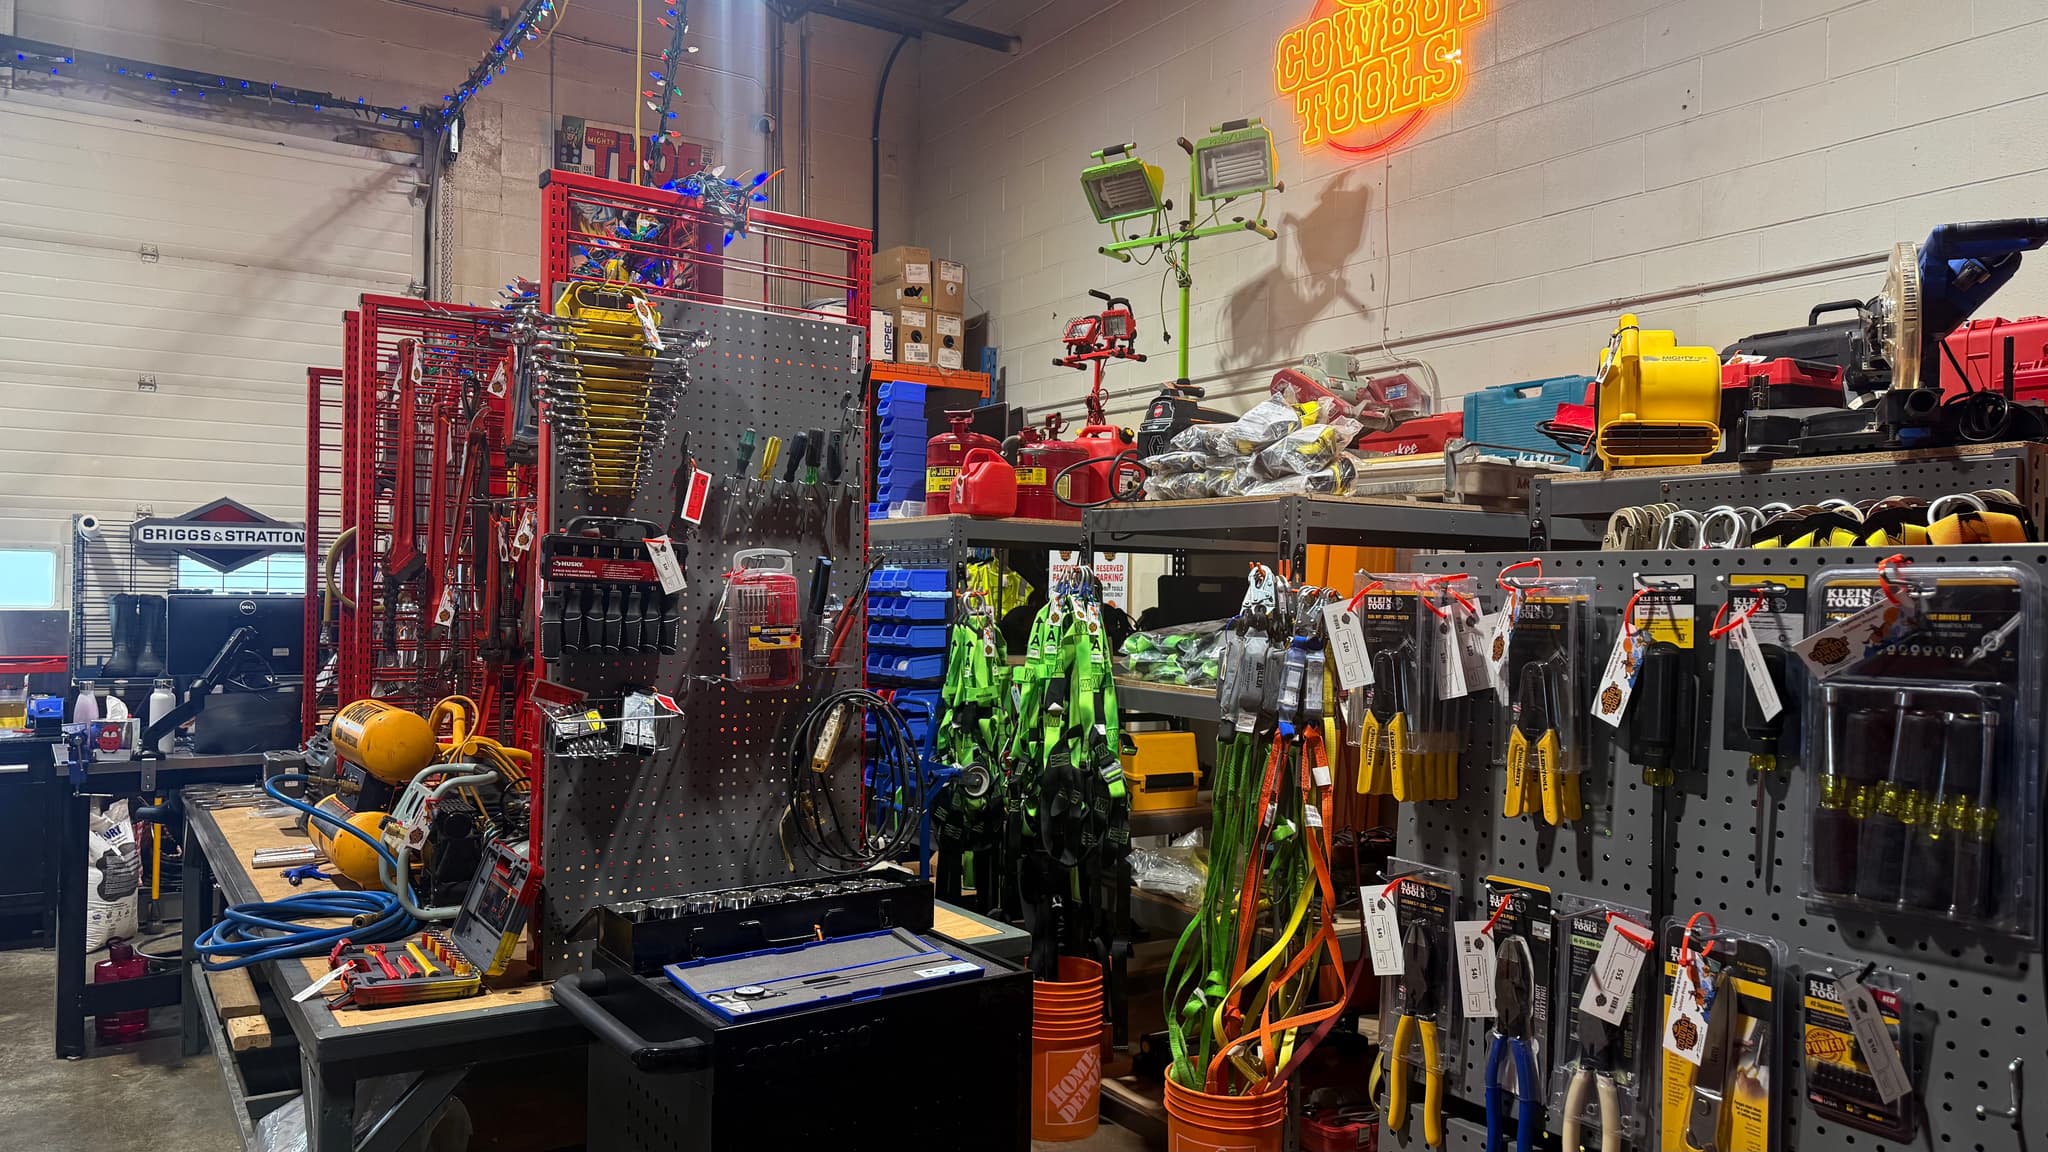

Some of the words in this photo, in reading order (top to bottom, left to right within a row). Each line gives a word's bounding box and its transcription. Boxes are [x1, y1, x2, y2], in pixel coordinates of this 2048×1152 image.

[1297, 29, 1457, 144] TOOLS
[587, 137, 615, 146] MIGHTY
[143, 528, 211, 541] BRIGGS
[213, 531, 223, 541] &
[225, 530, 305, 543] STRATTON
[1096, 564, 1124, 572] RESERVED
[1095, 573, 1124, 582] PARKING
[1827, 588, 1873, 598] KLEIN
[1733, 597, 1770, 605] KLEN
[1826, 597, 1871, 608] TOOLS
[1520, 611, 1540, 619] OOLS
[1938, 613, 1960, 621] DRIVER
[1342, 641, 1350, 653] $20
[1808, 636, 1849, 661] COWBOY
[1820, 645, 1850, 666] TOOLS
[1400, 881, 1425, 892] KLEIN
[1400, 887, 1425, 899] TOOLS
[1376, 927, 1384, 939] $45
[1573, 923, 1598, 933] TOOLS
[1615, 968, 1625, 981] $55
[1809, 980, 1837, 995] KLE
[1809, 988, 1841, 1002] TOOL
[1882, 995, 1897, 1004] NEW
[1676, 1013, 1690, 1051] COWBOY
[1685, 1023, 1698, 1051] TOOLS
[1806, 1038, 1845, 1055] POWER
[1049, 1048, 1098, 1108] HOME
